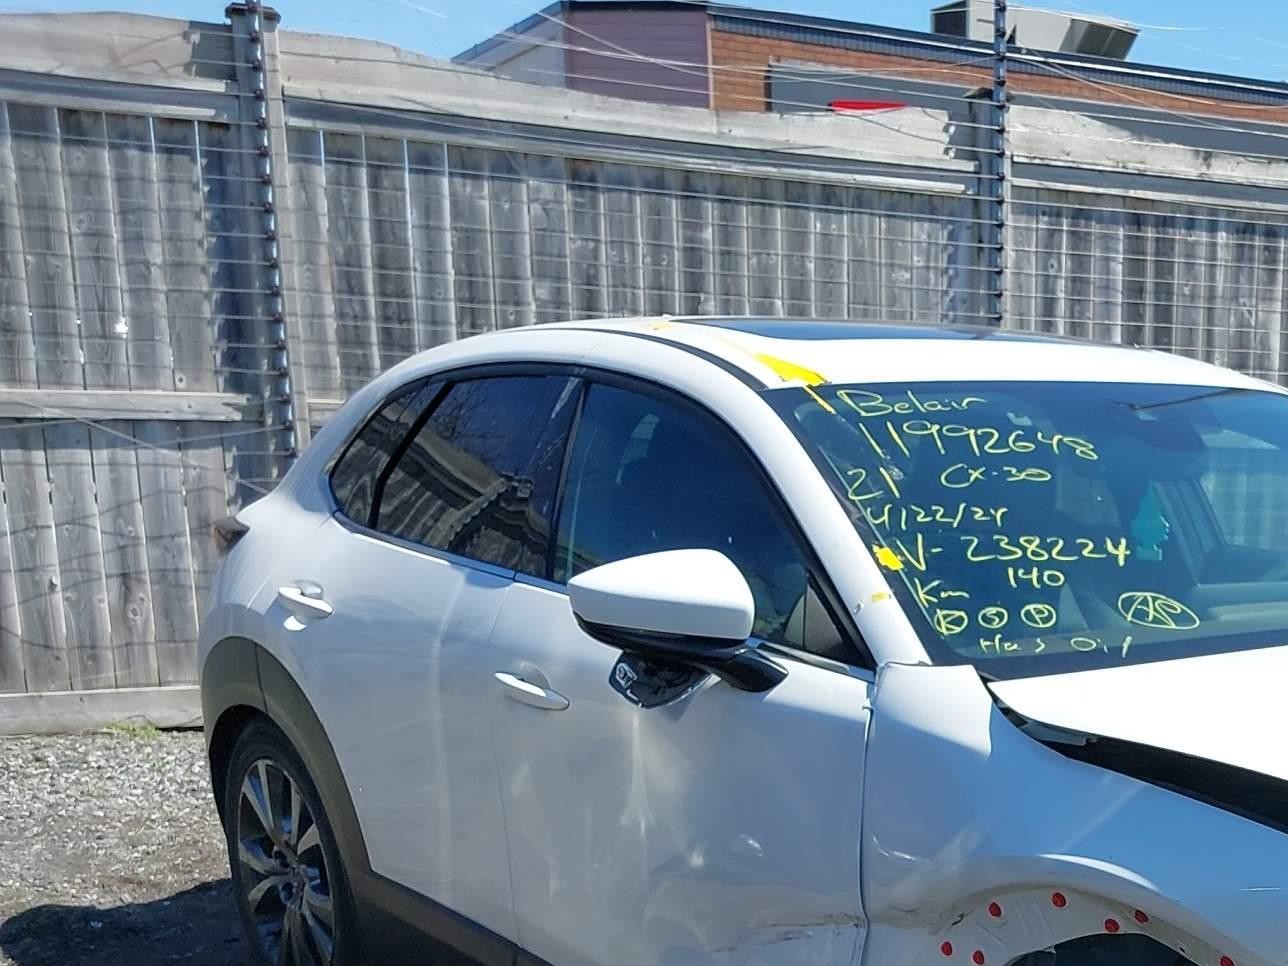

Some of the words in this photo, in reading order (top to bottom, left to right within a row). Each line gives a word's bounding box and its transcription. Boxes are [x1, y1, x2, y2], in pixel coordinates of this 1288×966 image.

[836, 389, 988, 417] Belair
[858, 419, 1099, 460] 11992648
[847, 467, 900, 500] 21
[960, 535, 1131, 568] 238224
[1007, 566, 1066, 589] 140
